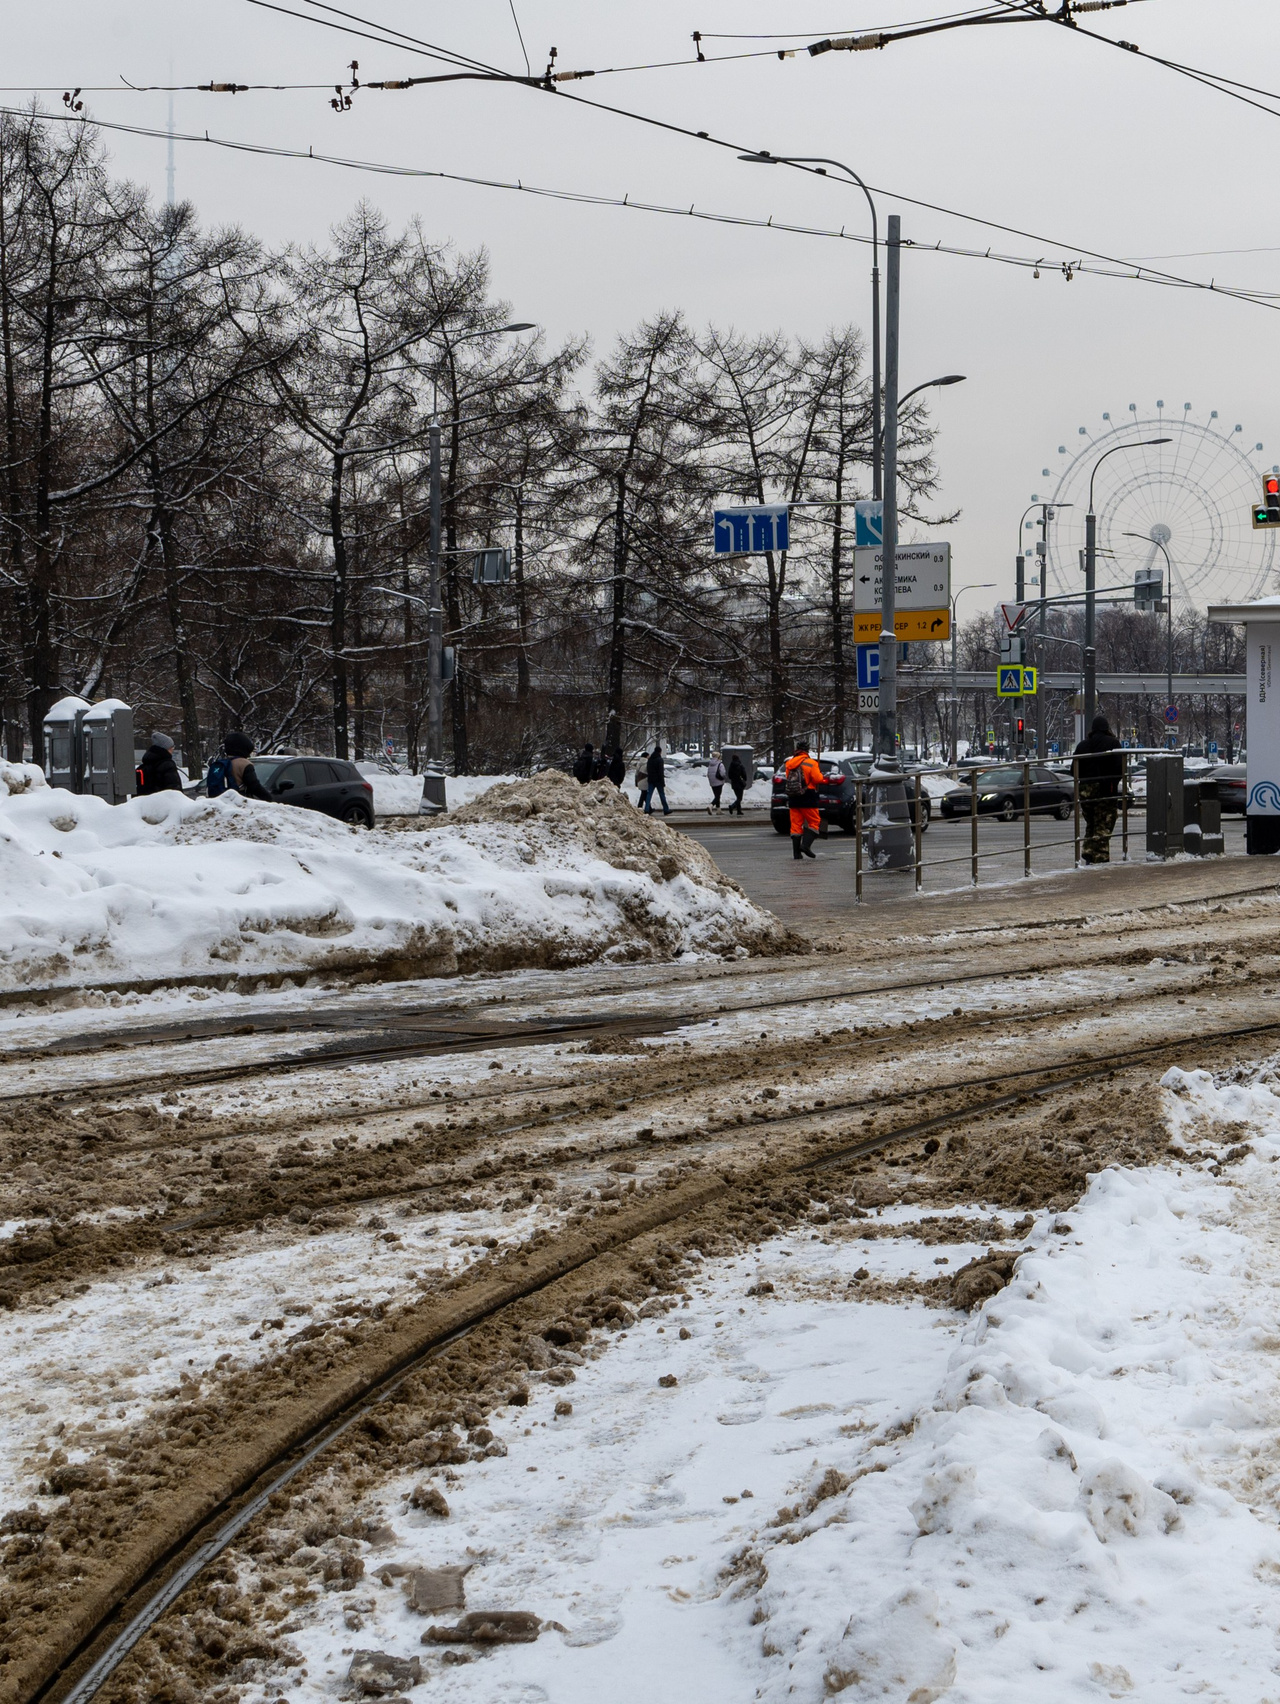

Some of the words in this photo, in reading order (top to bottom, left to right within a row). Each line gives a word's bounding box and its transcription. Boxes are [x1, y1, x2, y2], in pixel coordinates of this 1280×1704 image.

[874, 551, 930, 562] ОСНКИНСКИЙ
[933, 555, 944, 563] 0.9
[874, 575, 917, 585] АКЕМИКА
[874, 586, 912, 595] КОЛЕВА
[933, 584, 944, 592] 0.9
[858, 624, 869, 632] ЖК
[870, 622, 909, 631] РЕСЕР
[917, 621, 927, 630] 1.2
